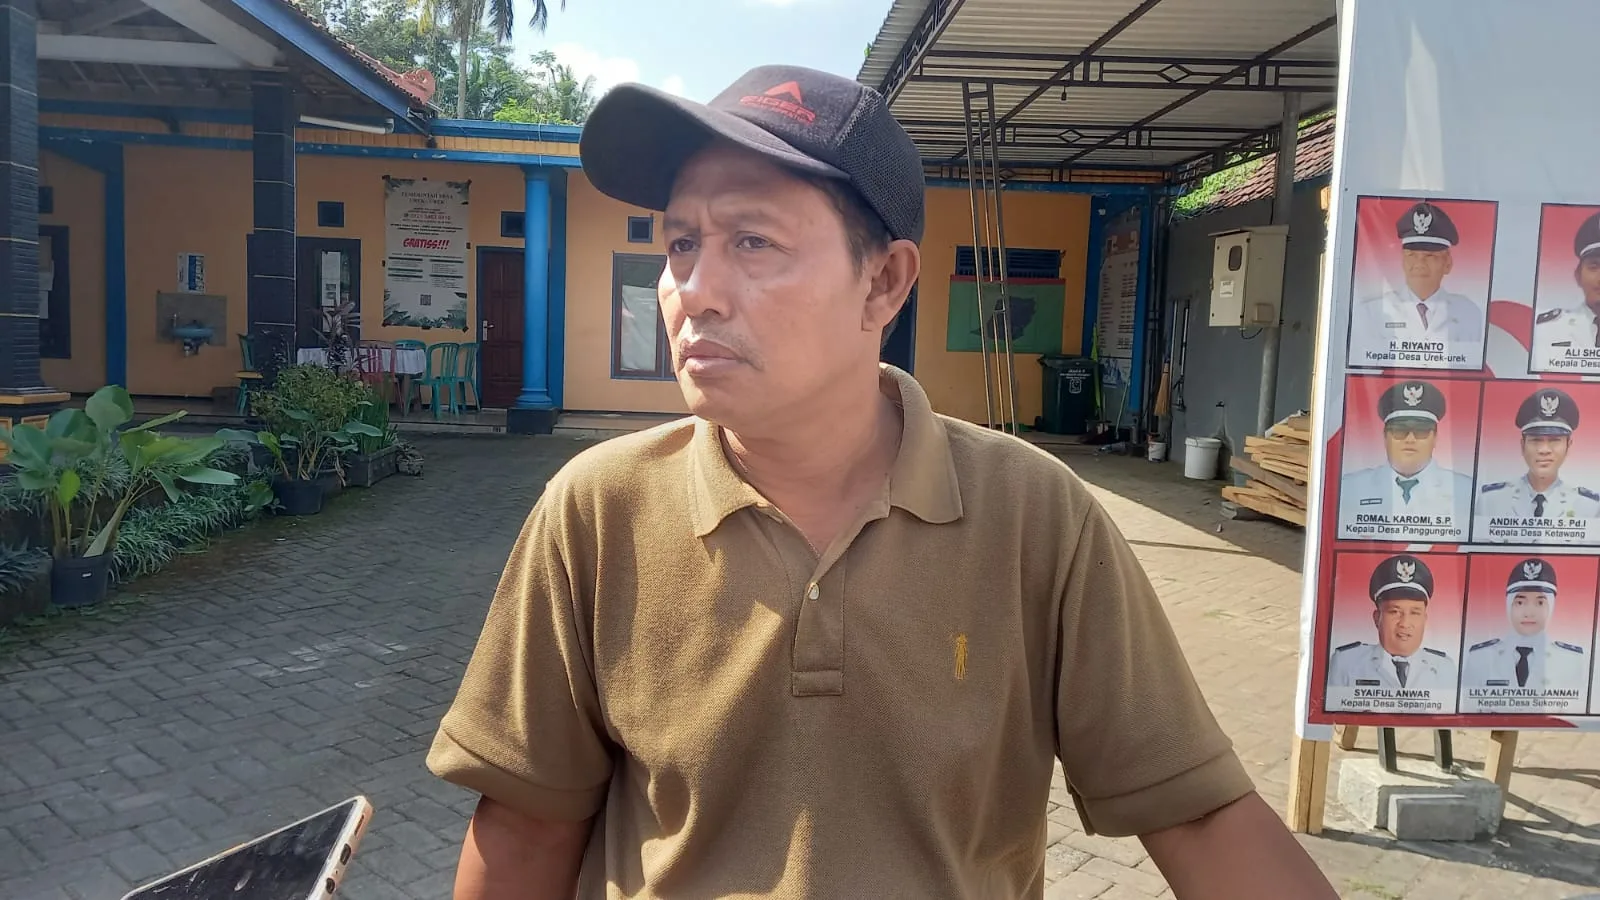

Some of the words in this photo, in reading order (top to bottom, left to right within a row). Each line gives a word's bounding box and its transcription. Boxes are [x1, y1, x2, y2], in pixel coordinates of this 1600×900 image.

[1390, 341, 1399, 350] H.
[1401, 341, 1444, 351] RIYANTO
[1366, 351, 1396, 361] Kepala
[1398, 352, 1421, 361] Desa
[1423, 353, 1466, 363] Urek-urek
[1565, 348, 1581, 357] ALI
[1549, 358, 1578, 368] Kepala
[1356, 514, 1391, 523] ROMAL
[1393, 515, 1433, 526] KAROMI,
[1489, 518, 1519, 526] ANDIK
[1521, 518, 1555, 529] AS'ARI,
[1557, 519, 1567, 527] S.
[1346, 524, 1375, 534] Kepala
[1377, 525, 1400, 534] Desa
[1402, 526, 1462, 537] Panggungrejo
[1489, 528, 1519, 538] Kepala
[1520, 529, 1542, 538] Desa
[1544, 530, 1586, 540] Ketawang
[1354, 688, 1394, 698] SYAIFUL
[1395, 690, 1430, 698] ANWAR
[1469, 688, 1489, 697] LILY
[1490, 688, 1539, 697] ALFIYATUL
[1540, 689, 1580, 698] JANNAH
[1341, 698, 1371, 708] Kepala
[1373, 700, 1395, 708] Desa
[1397, 700, 1443, 711] Sepanjang
[1478, 699, 1506, 709] Kepala
[1508, 700, 1530, 708] Desa
[1532, 700, 1569, 709] Sukorejo
